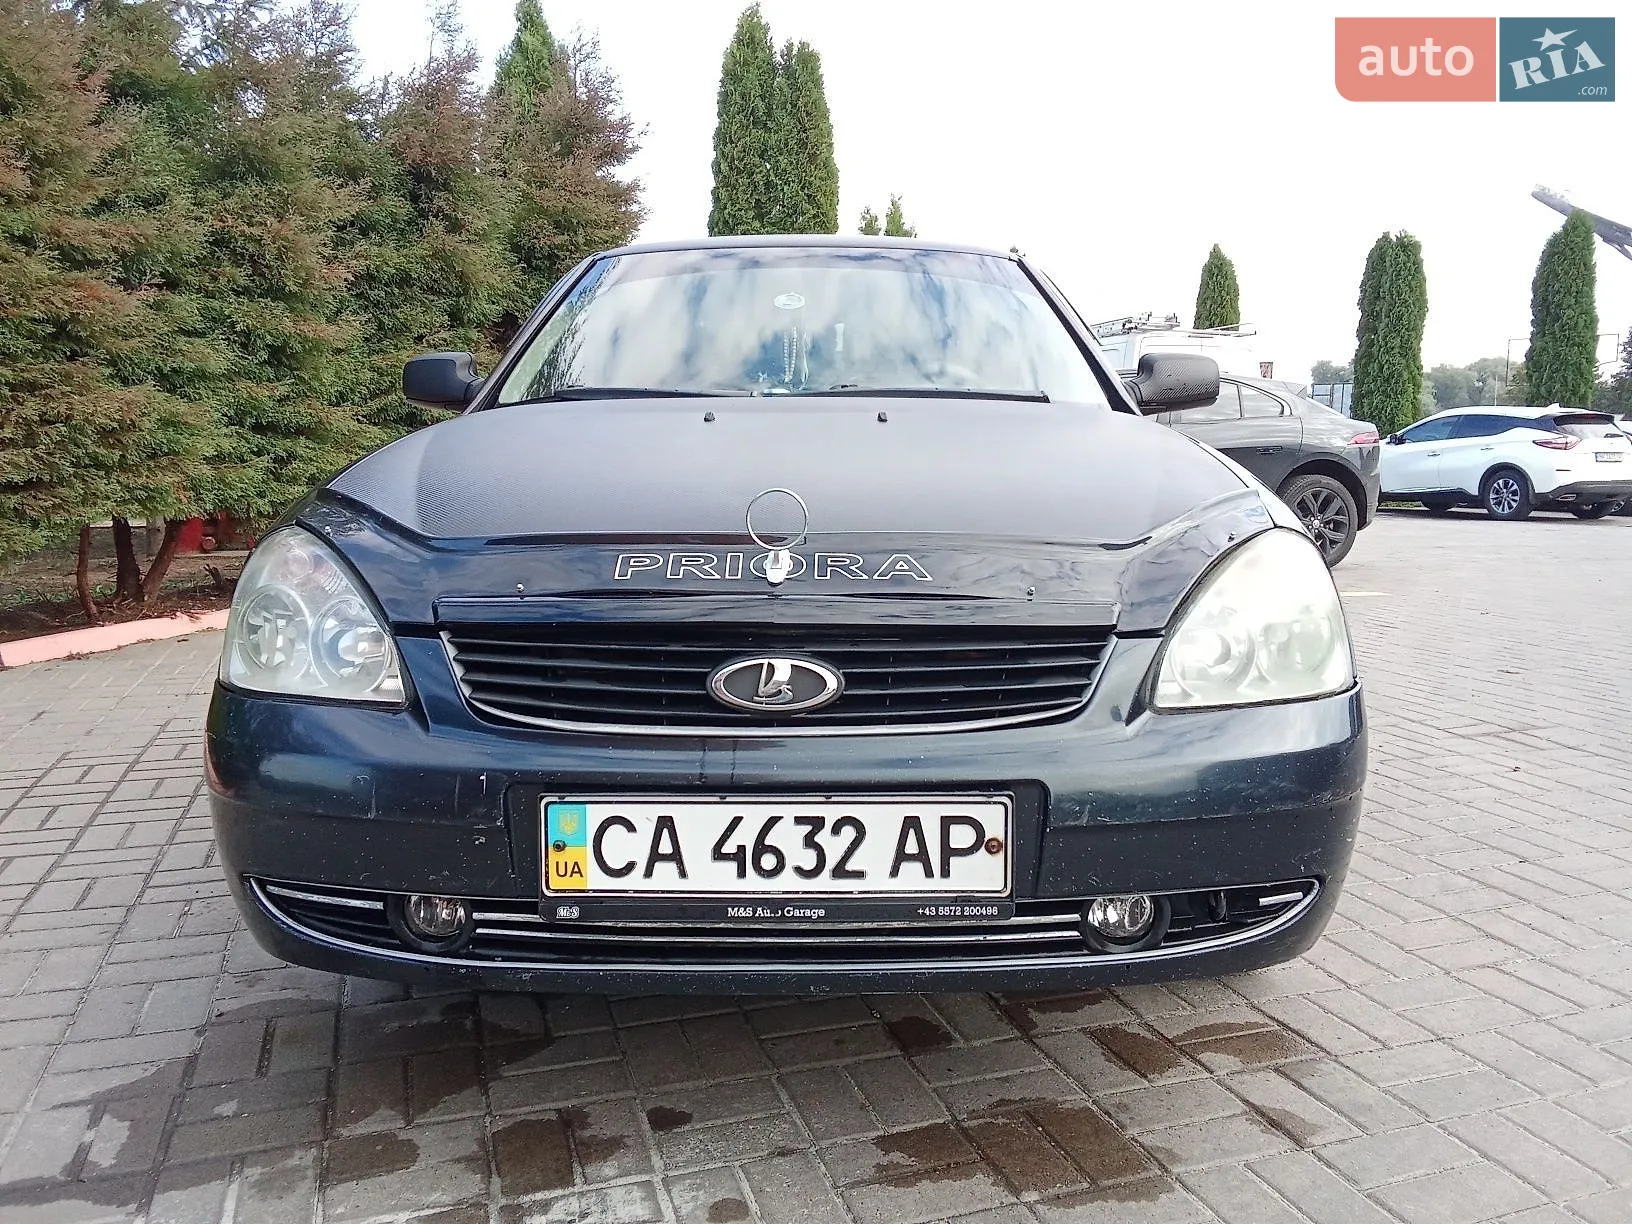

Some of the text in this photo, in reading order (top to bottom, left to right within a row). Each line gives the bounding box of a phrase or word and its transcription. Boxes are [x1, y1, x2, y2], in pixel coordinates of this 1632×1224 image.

[613, 553, 933, 581] PRIORA
[592, 815, 986, 880] CA 4632 AP
[555, 861, 584, 878] UA
[727, 907, 753, 917] M&S
[783, 906, 826, 919] Garage
[917, 906, 998, 916] +43 5572 200496
